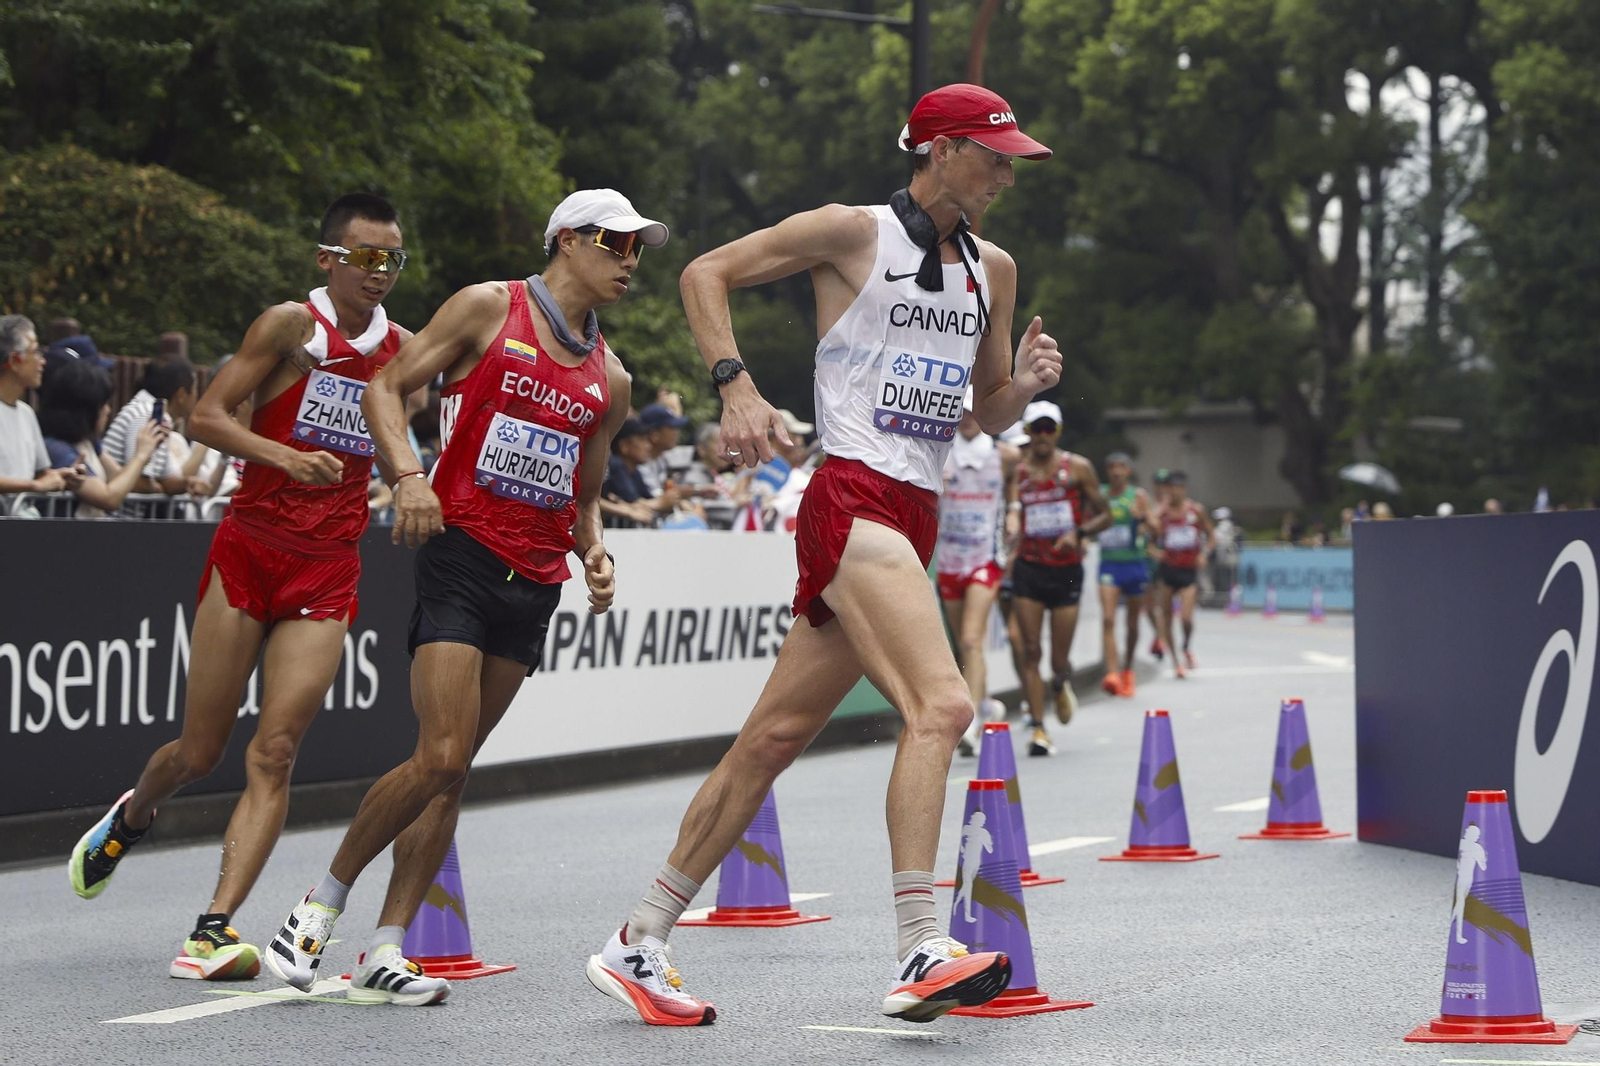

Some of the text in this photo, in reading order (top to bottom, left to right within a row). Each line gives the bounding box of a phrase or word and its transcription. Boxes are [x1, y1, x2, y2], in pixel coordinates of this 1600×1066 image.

[989, 111, 1017, 125] CAN
[501, 371, 594, 429] ECUADOR
[481, 444, 563, 487] HURTADO
[521, 425, 579, 463] TDK
[538, 605, 792, 672] PAN AIRLINES
